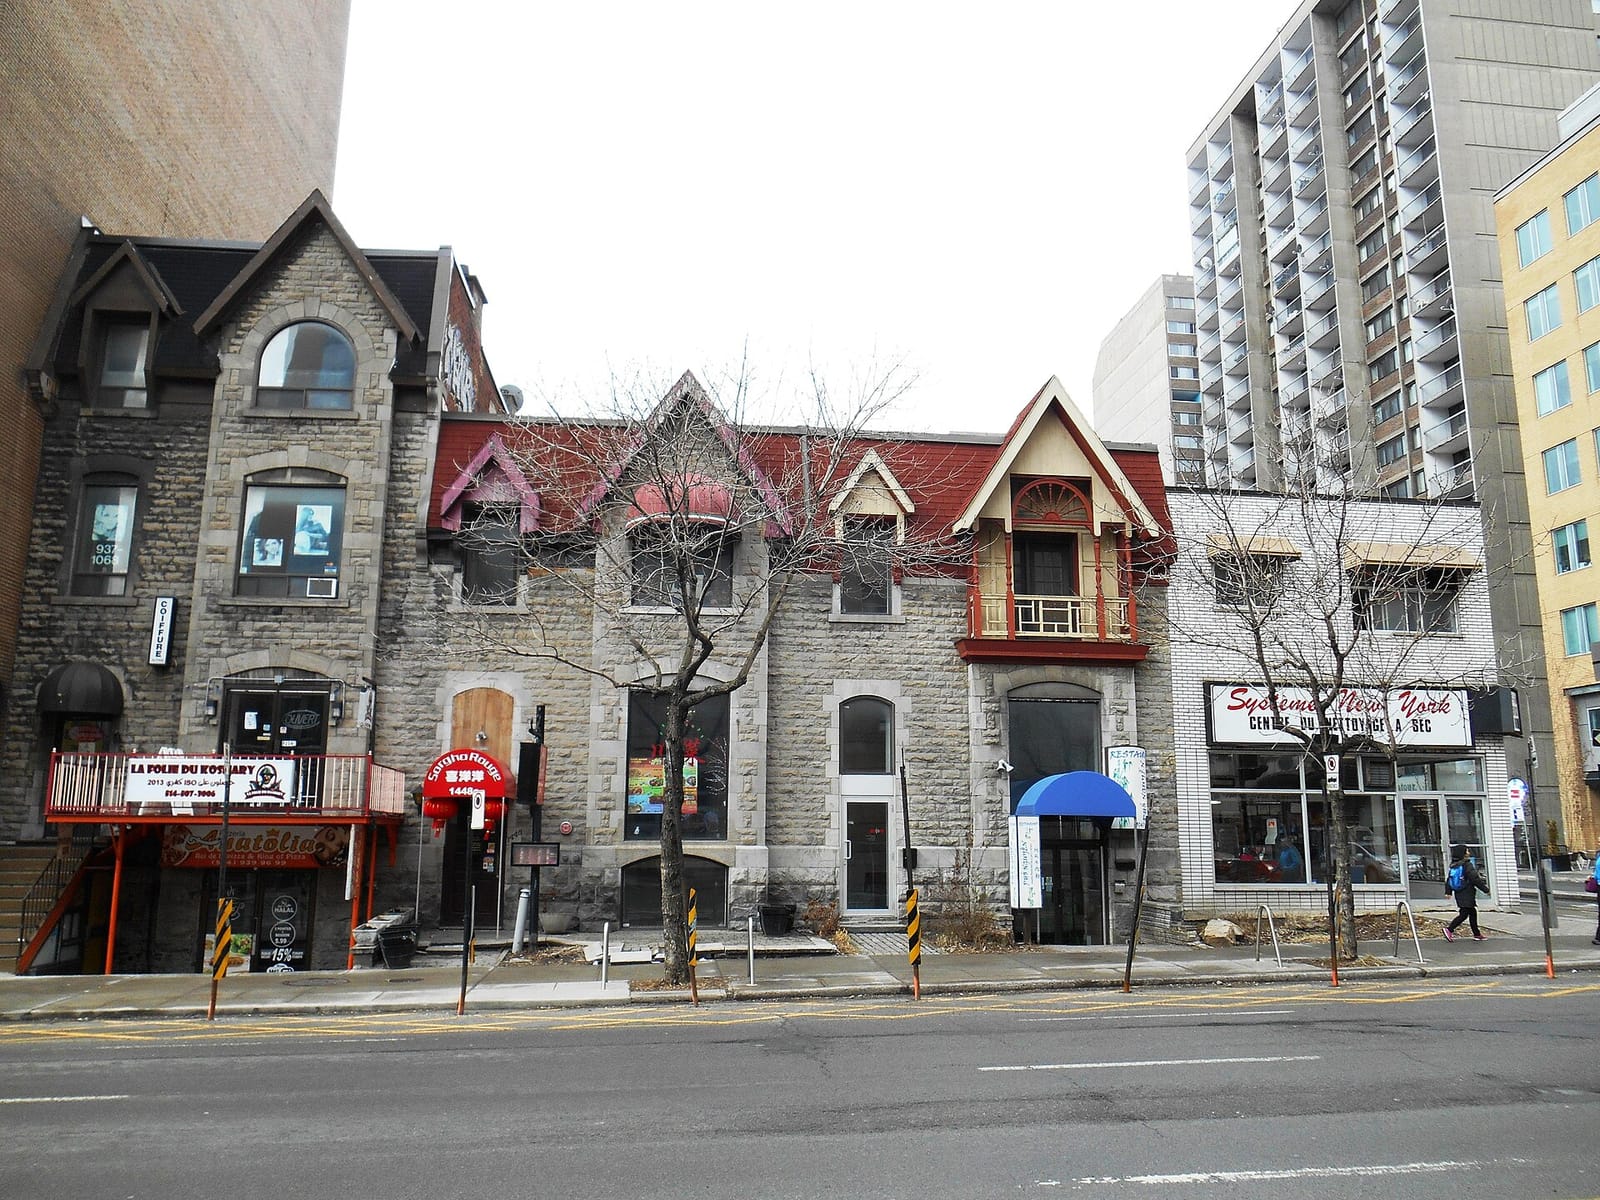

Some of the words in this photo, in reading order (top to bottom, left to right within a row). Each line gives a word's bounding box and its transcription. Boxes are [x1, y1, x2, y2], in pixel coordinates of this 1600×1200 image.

[155, 600, 168, 658] COIFFURE
[1339, 688, 1385, 713] New
[1398, 690, 1451, 718] York
[1300, 716, 1315, 731] DU
[1412, 718, 1432, 733] SEC
[130, 763, 145, 774] LA
[146, 763, 179, 774] FOLIE
[181, 764, 198, 774] DU
[200, 764, 255, 775] KOSARY
[427, 753, 468, 782] Sorgho
[468, 752, 502, 782] Rouge
[184, 829, 318, 852] Anatolia
[271, 947, 293, 962] 15%
